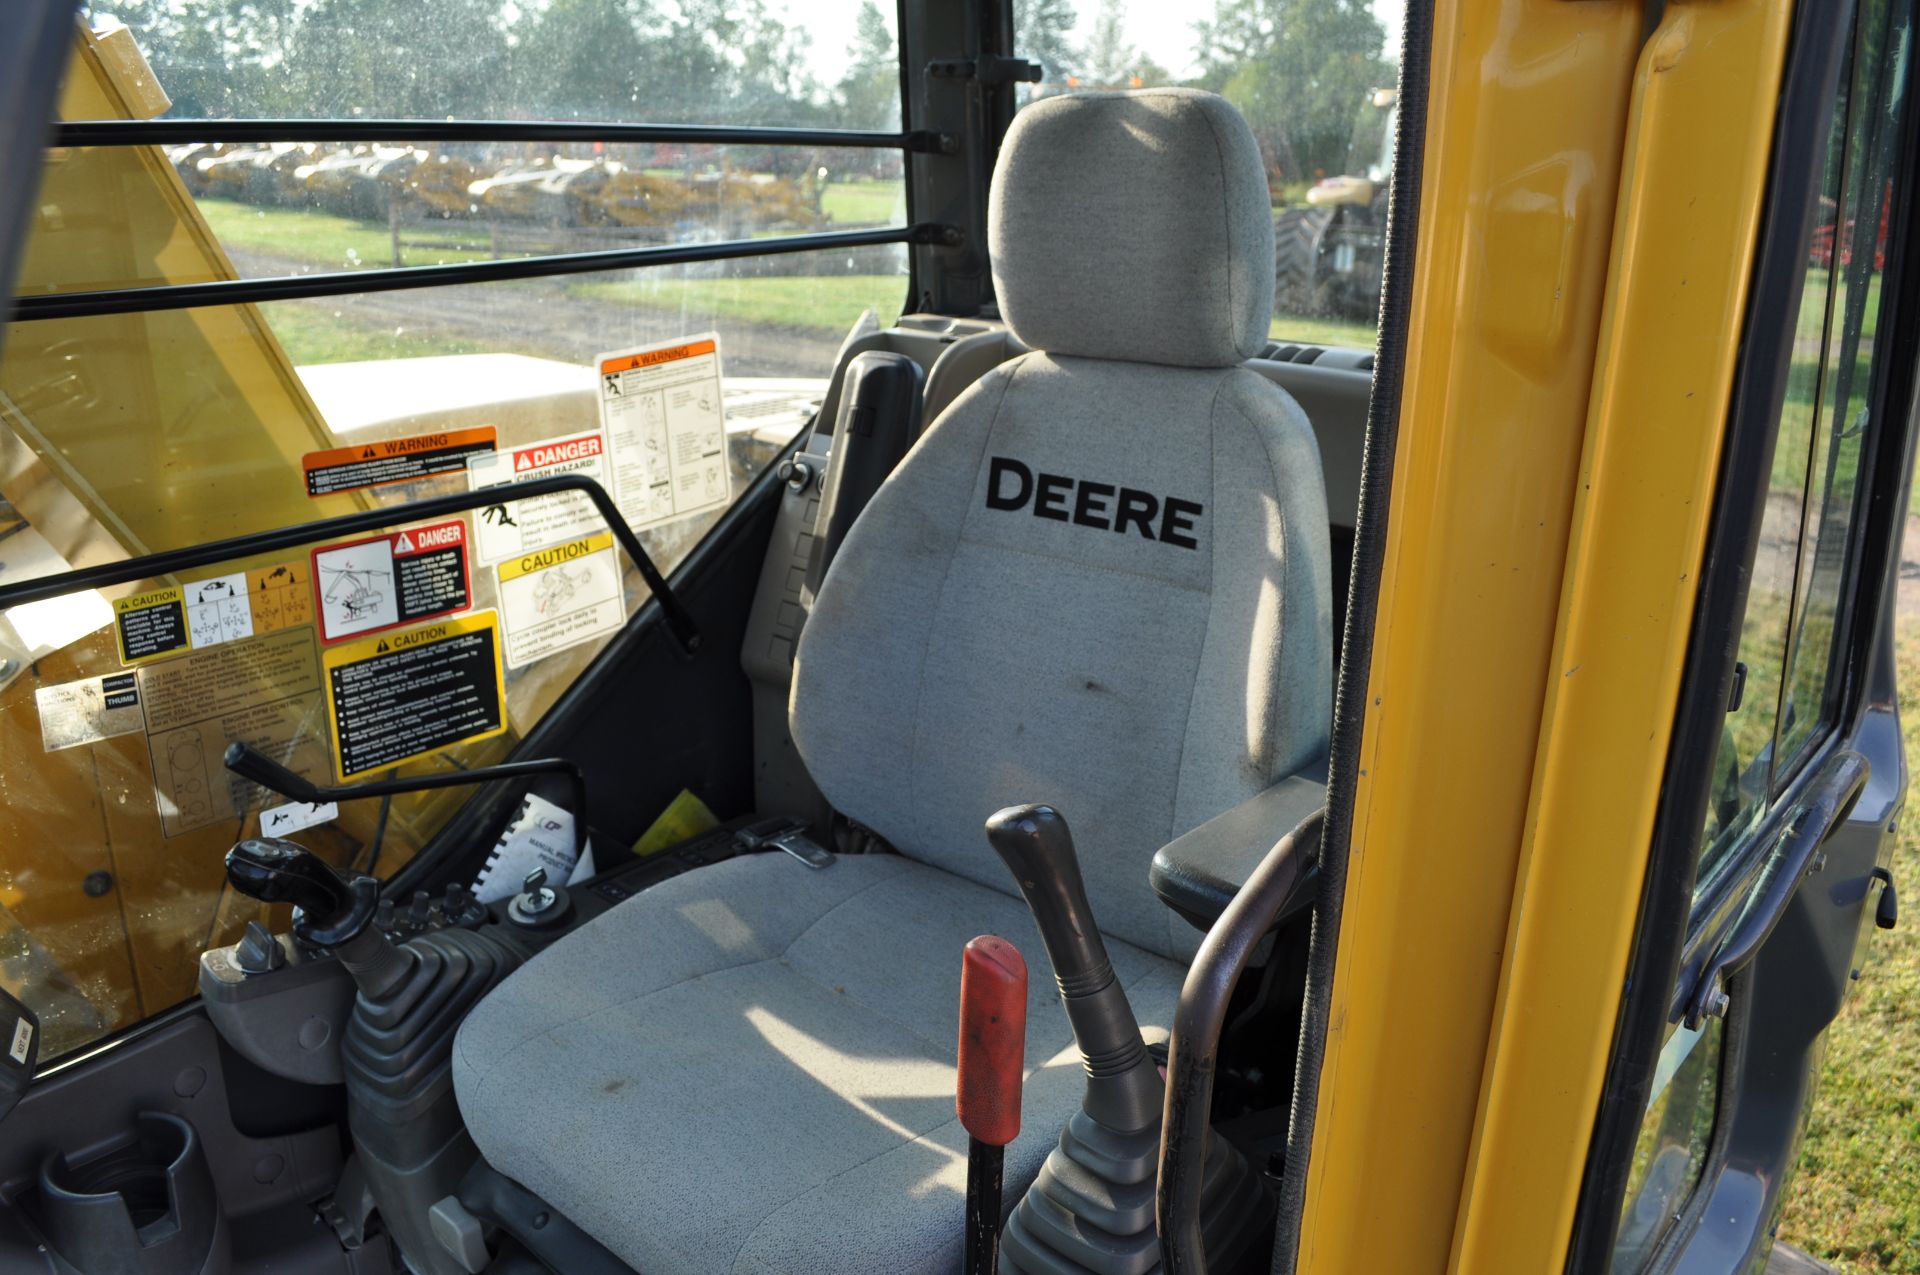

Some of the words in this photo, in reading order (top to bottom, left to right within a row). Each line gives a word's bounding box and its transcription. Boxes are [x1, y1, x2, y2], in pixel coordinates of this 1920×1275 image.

[640, 346, 689, 366] WARNING
[385, 434, 448, 454] WARNING
[533, 438, 600, 466] DANGER
[554, 459, 596, 475] HAZARD!
[985, 456, 1204, 550] DEERE
[418, 525, 461, 548] DANGER
[521, 540, 589, 572] CAUTION
[132, 591, 177, 607] CAUTION
[124, 610, 150, 618] Alternate
[152, 604, 172, 613] control
[126, 616, 148, 625] patterns
[127, 622, 151, 630] available
[147, 630, 166, 638] control
[393, 627, 446, 648] CAUTION
[129, 639, 154, 648] response
[190, 652, 219, 665] ENGINE
[221, 642, 265, 659] OPERATION
[107, 694, 135, 706] THUMB
